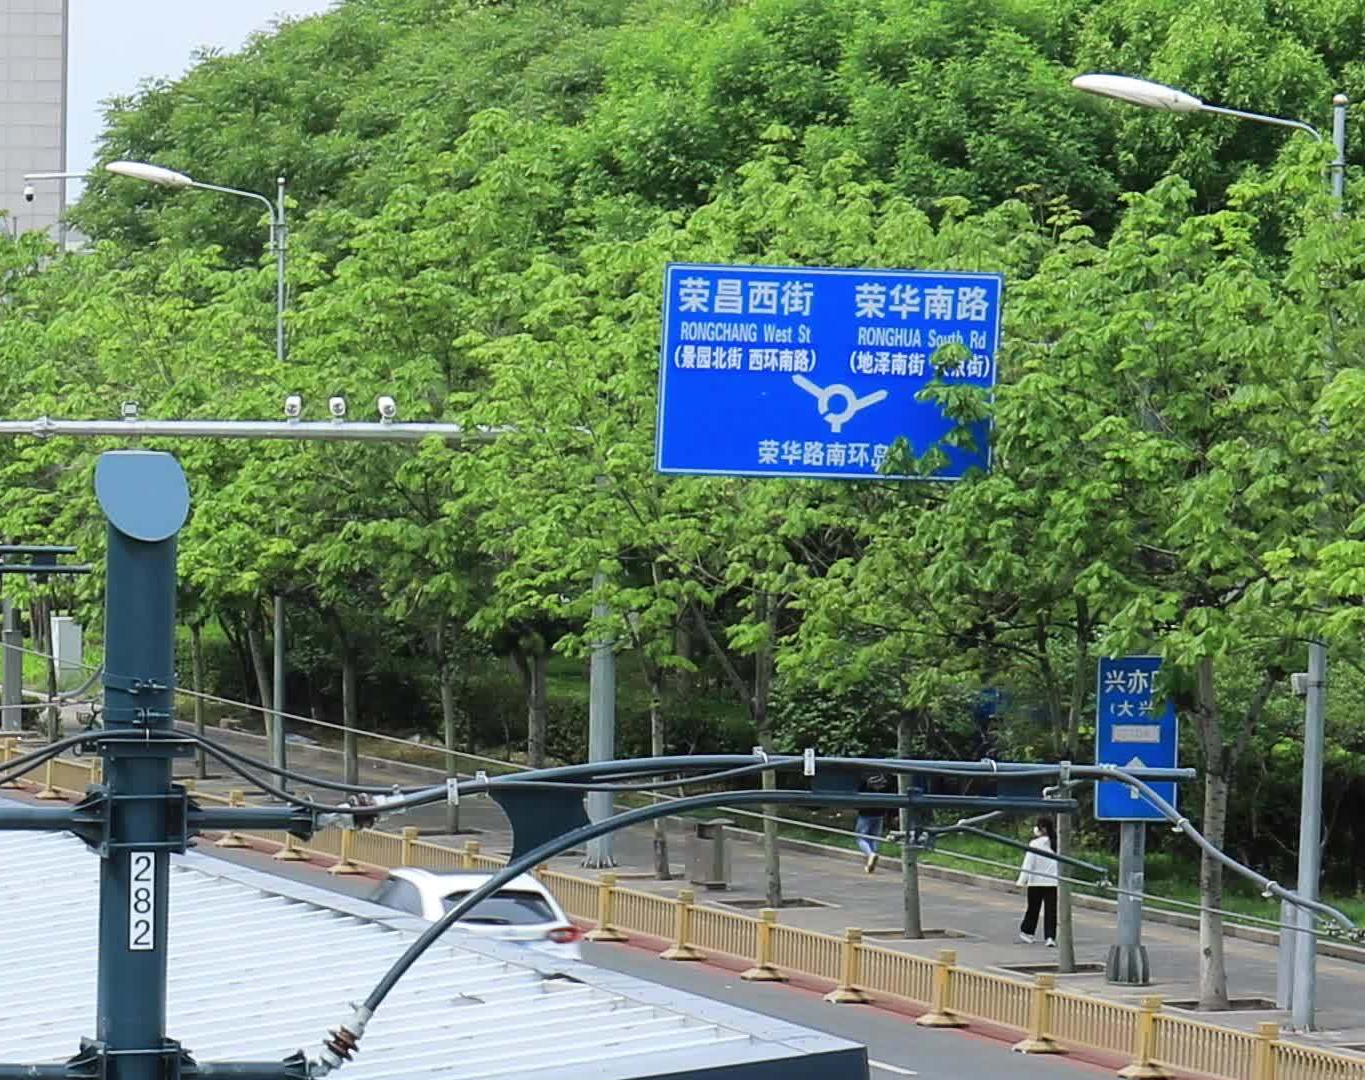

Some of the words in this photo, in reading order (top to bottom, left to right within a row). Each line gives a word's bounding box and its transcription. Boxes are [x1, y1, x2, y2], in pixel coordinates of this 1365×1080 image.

[678, 277, 814, 316] 荣昌西街
[854, 283, 989, 321] 荣华南路
[680, 321, 757, 342] RONGCHANG
[763, 323, 792, 344] West
[798, 324, 811, 345] St
[858, 327, 921, 347] RONGHUA
[970, 331, 986, 349] Rd
[748, 348, 817, 372] 西环南路)
[850, 351, 926, 376] (地泽南街
[133, 856, 151, 945] 282
